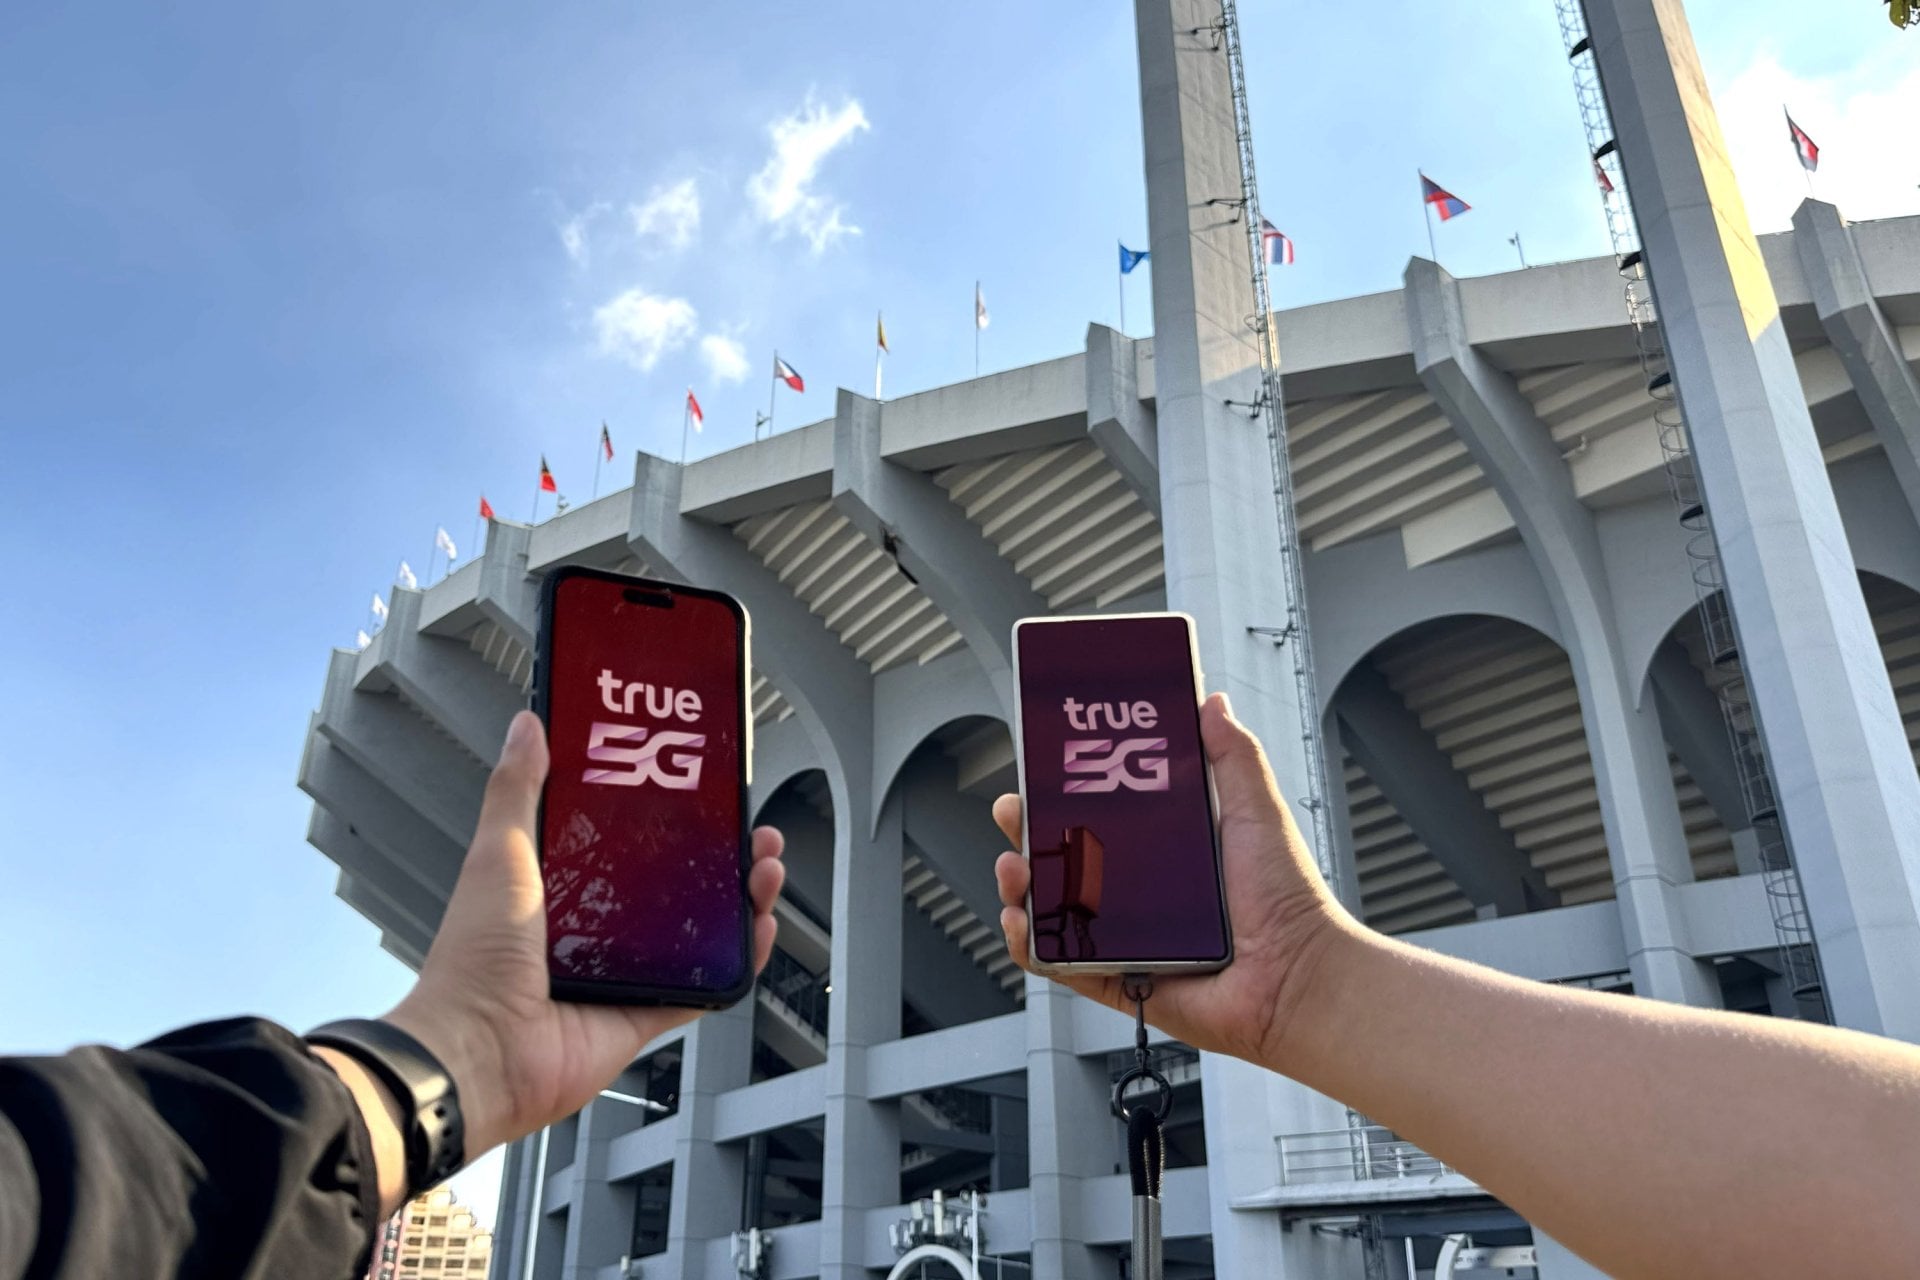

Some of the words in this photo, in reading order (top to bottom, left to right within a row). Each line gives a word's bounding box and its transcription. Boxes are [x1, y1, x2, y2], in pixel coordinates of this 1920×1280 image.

[597, 669, 703, 722] true
[1063, 697, 1158, 730] true
[582, 722, 706, 791] 5G
[1063, 737, 1171, 793] 5G
